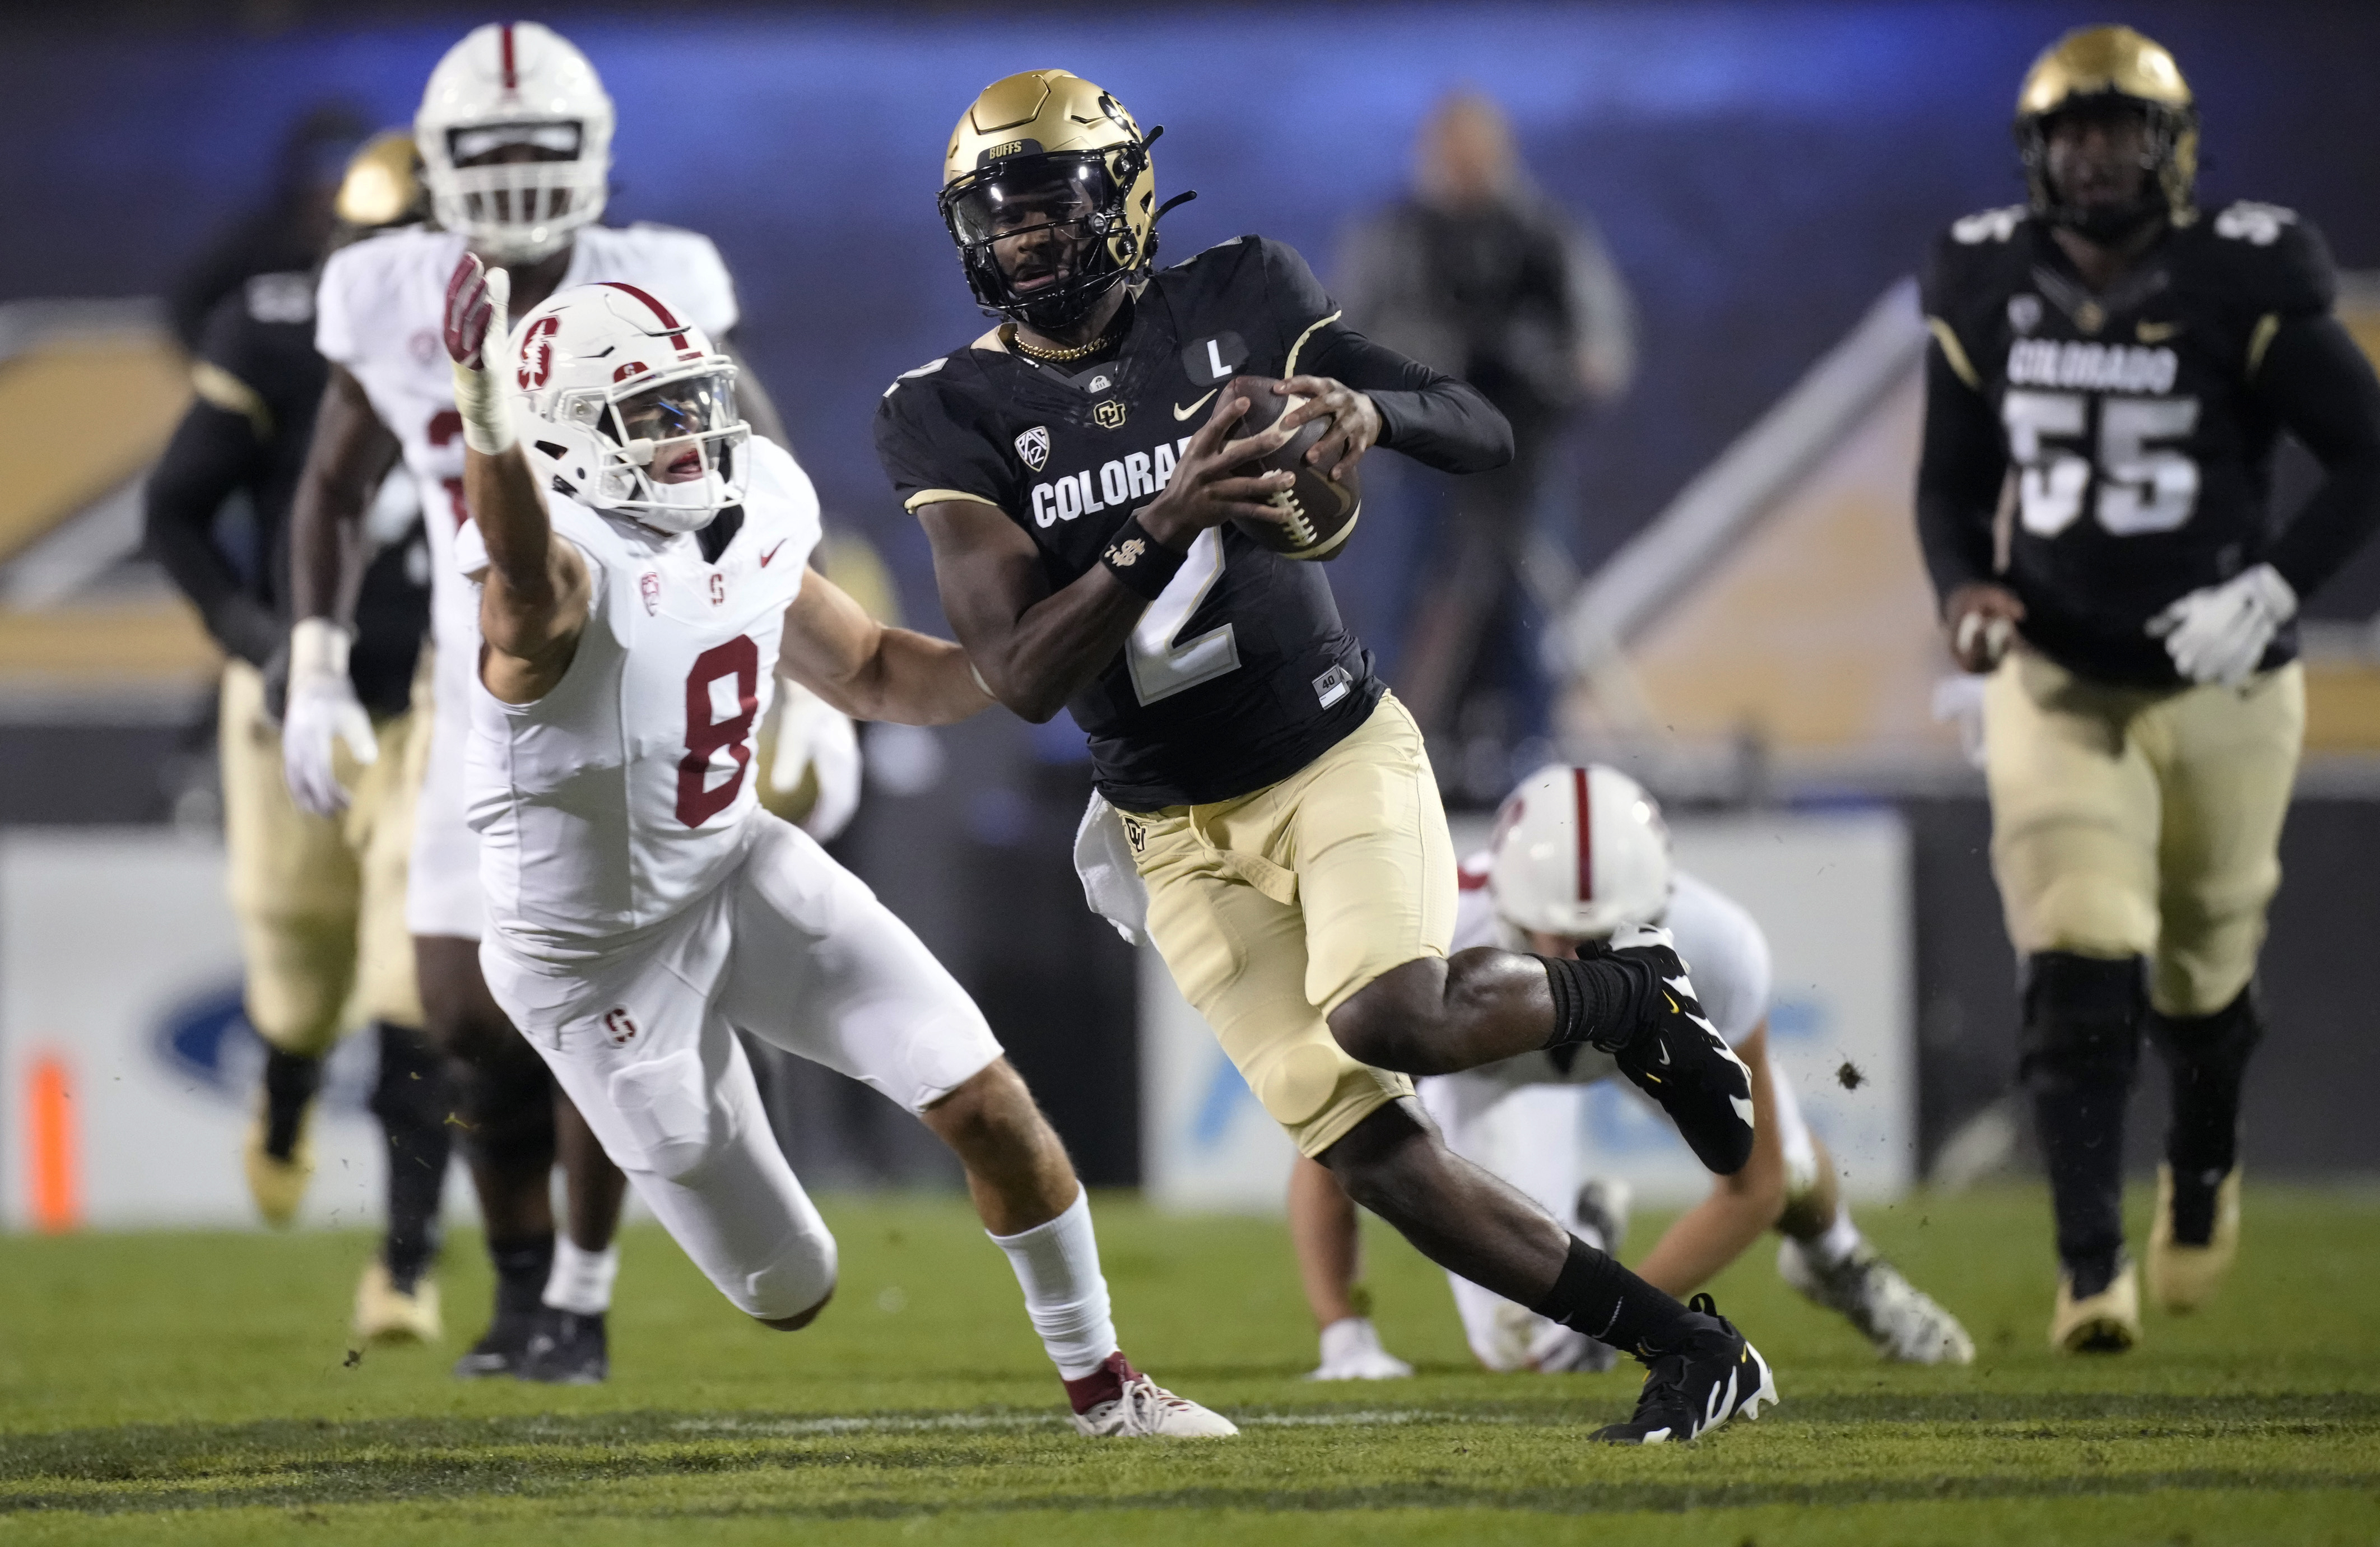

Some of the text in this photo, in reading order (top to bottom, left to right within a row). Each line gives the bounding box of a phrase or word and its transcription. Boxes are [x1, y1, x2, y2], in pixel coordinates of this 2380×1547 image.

[989, 141, 1021, 160] BUFFS
[1206, 339, 1233, 379] L
[1015, 428, 1048, 460] PAC
[1028, 445, 1045, 465] 12
[2000, 388, 2203, 539] 55
[1031, 435, 1192, 529] COLORA
[1125, 505, 1242, 708] 2
[1322, 675, 1335, 689] 40
[675, 634, 759, 829] 8
